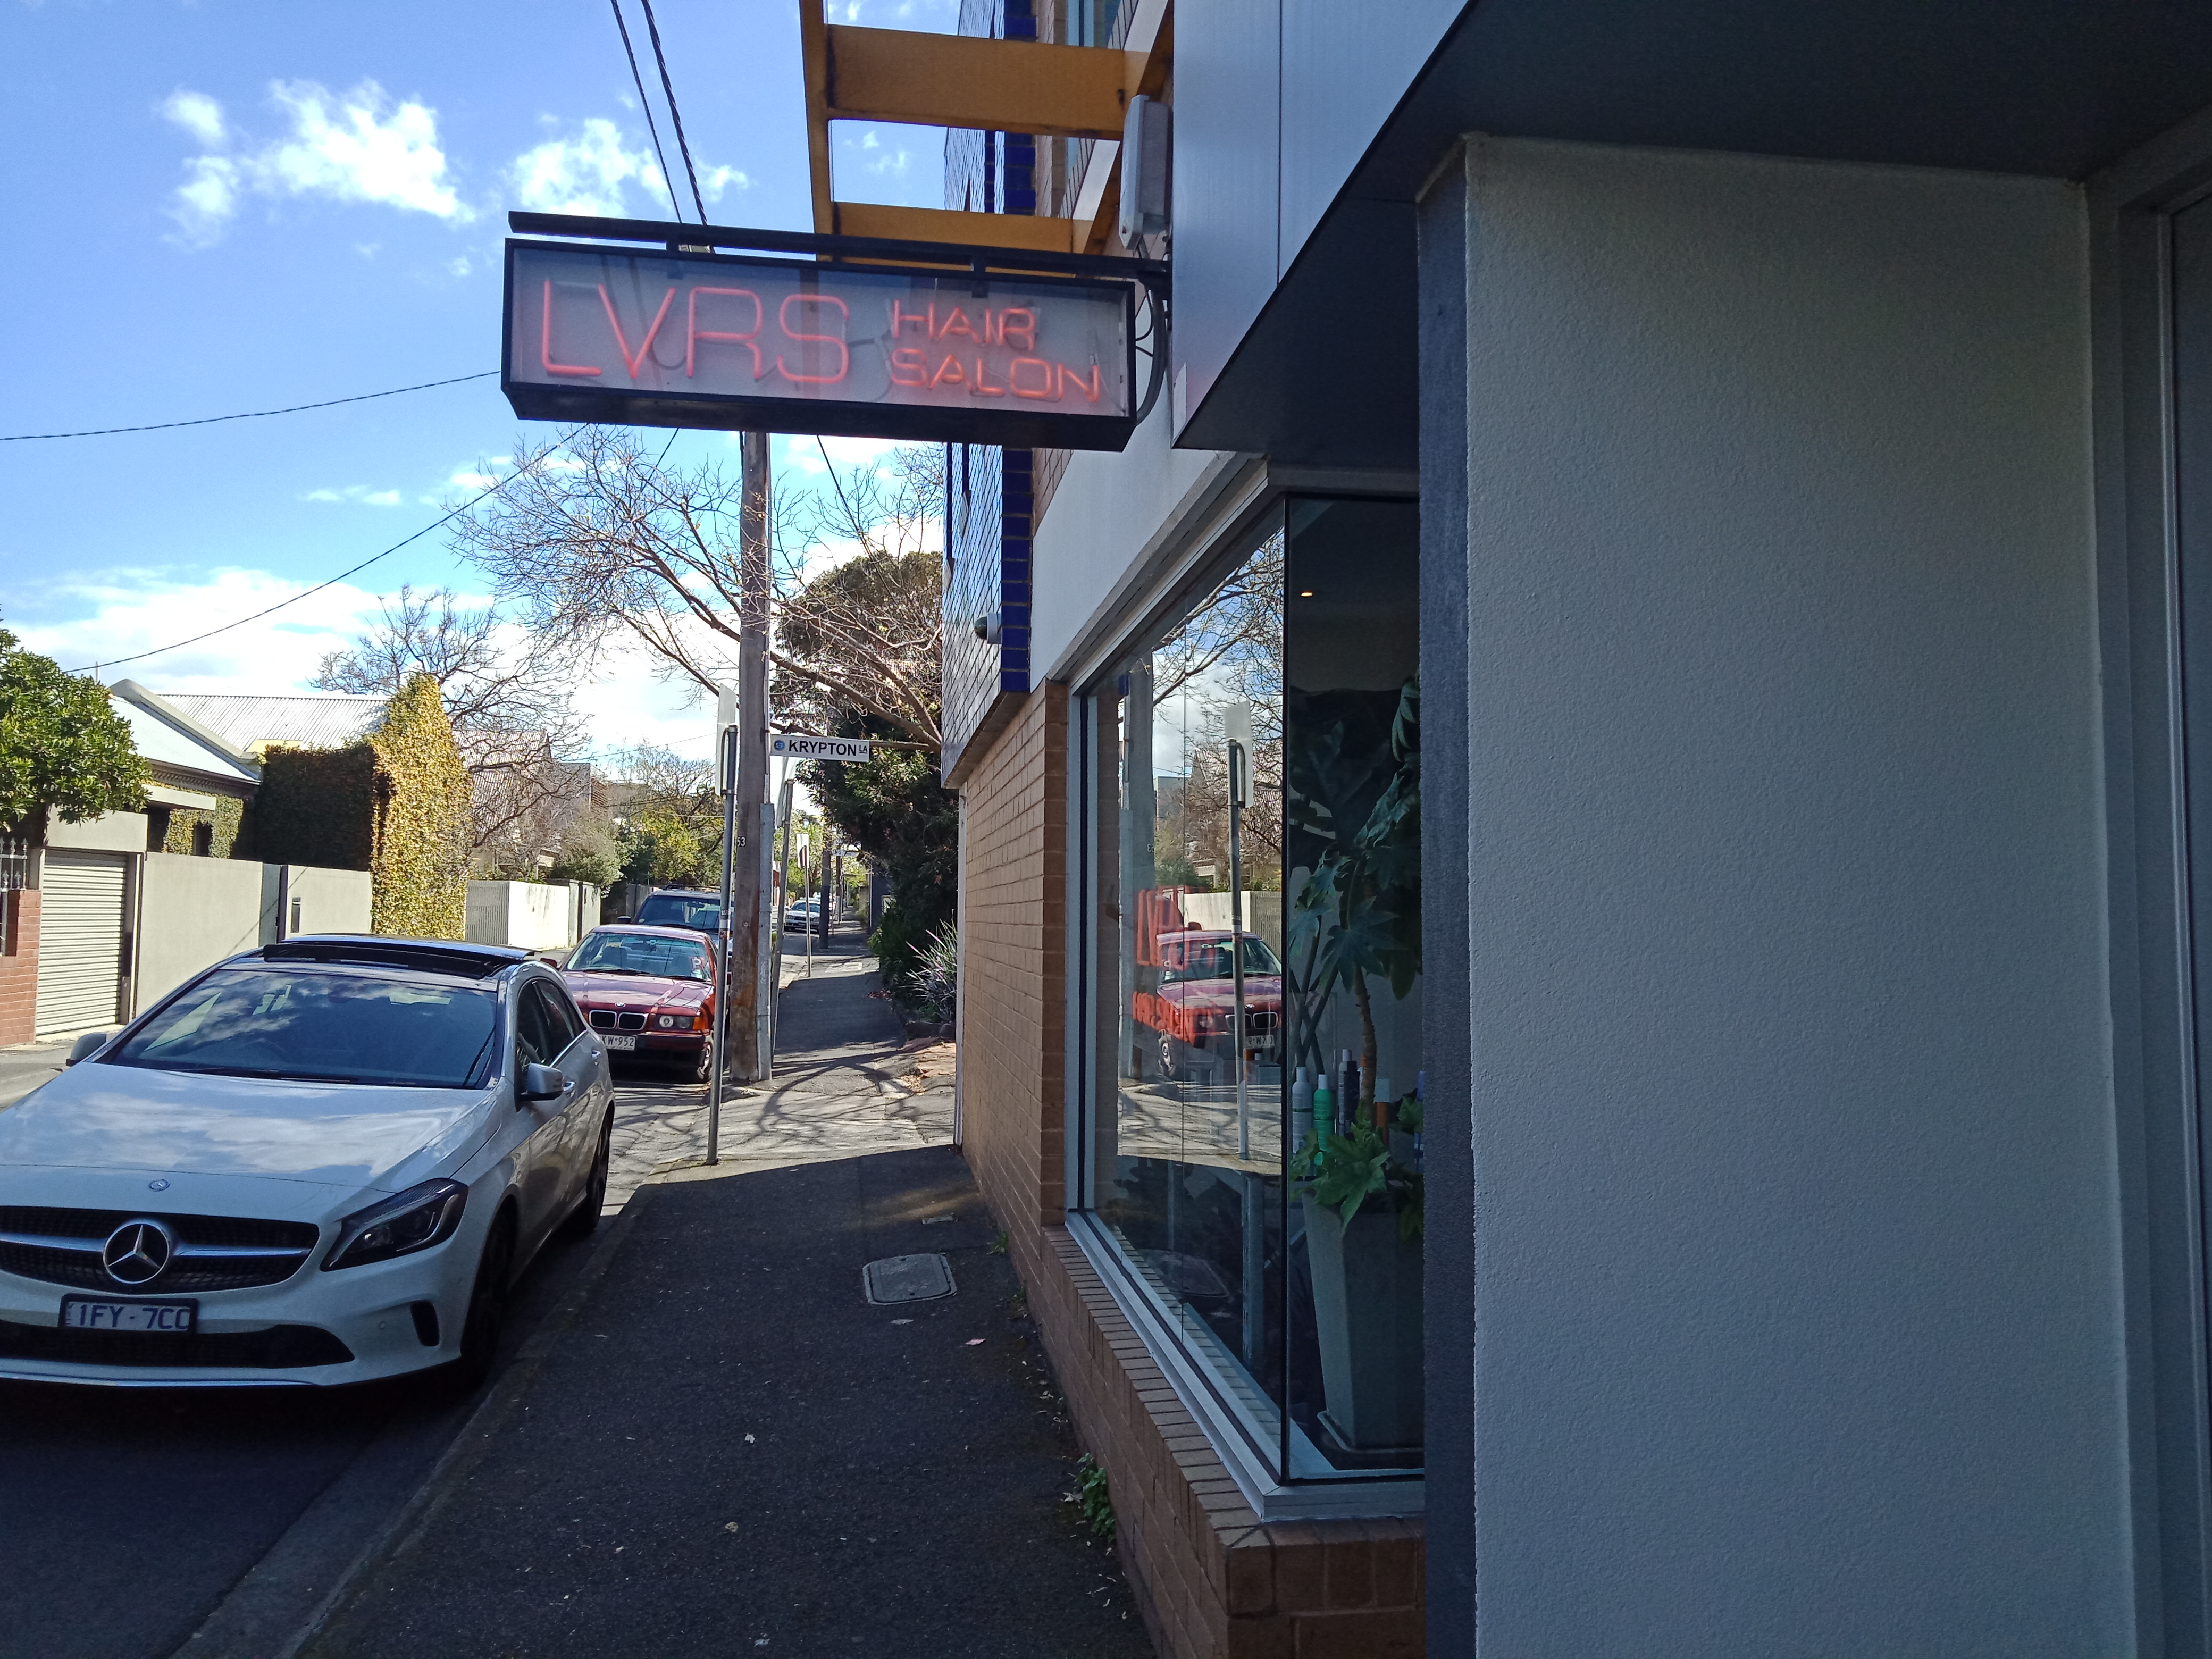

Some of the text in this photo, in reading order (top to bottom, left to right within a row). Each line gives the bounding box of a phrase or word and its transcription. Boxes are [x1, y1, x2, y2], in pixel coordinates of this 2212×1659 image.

[541, 279, 850, 384] LVRS
[892, 299, 1035, 350] HAIR
[890, 347, 1100, 403] SALON
[789, 740, 857, 756] KRYPTON
[692, 957, 702, 969] P
